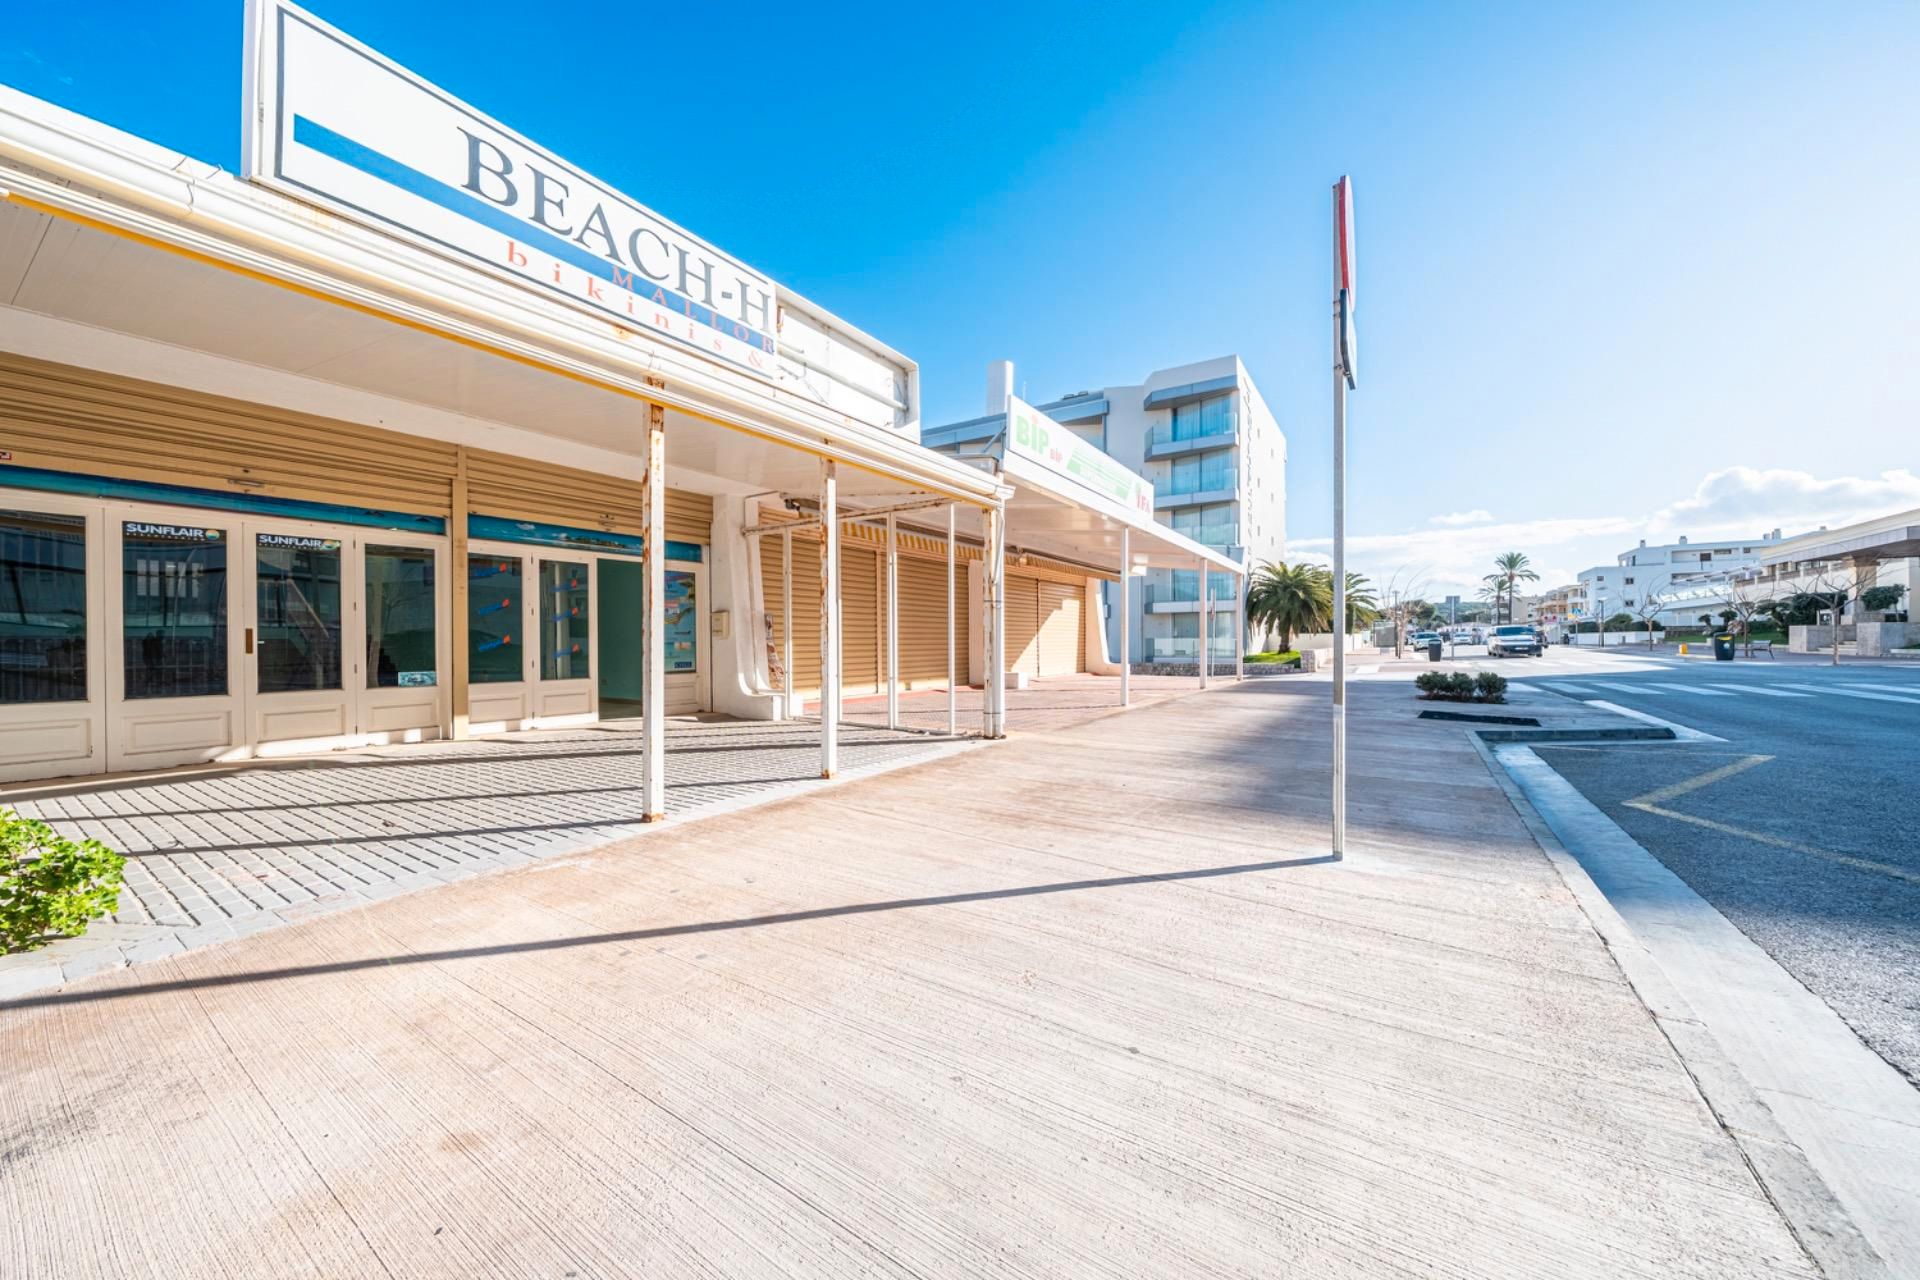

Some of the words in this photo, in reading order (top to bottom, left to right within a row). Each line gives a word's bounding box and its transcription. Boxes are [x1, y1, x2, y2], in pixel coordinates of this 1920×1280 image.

[456, 126, 771, 333] BEACH-H
[507, 240, 723, 352] bikinis
[612, 264, 775, 355] MALLOR
[126, 523, 204, 538] SUNFLAIR
[259, 535, 322, 549] SUNFLAIR
